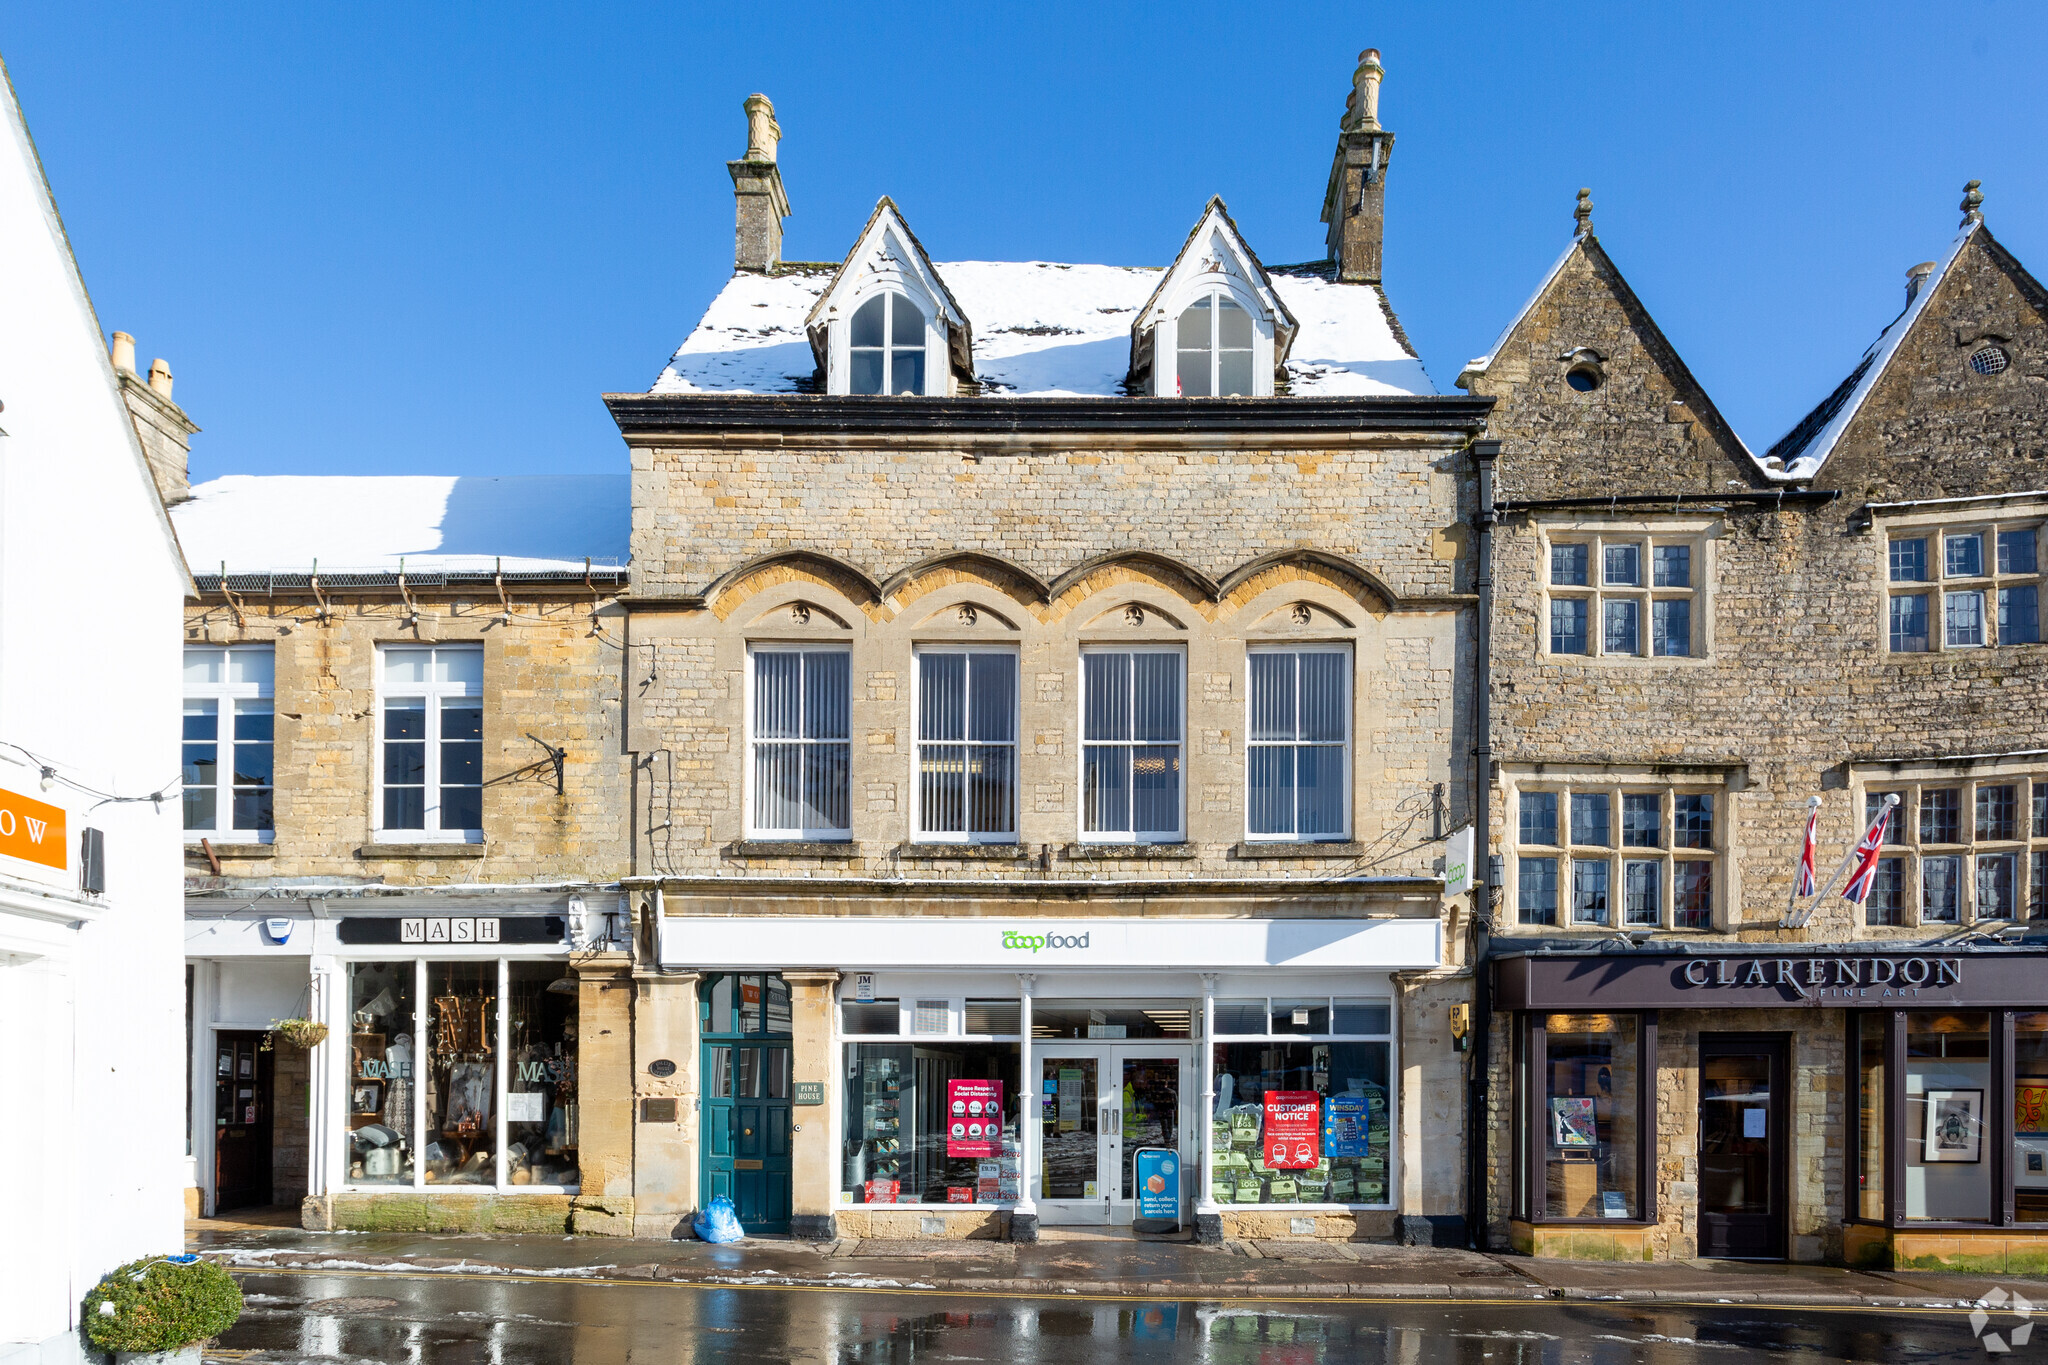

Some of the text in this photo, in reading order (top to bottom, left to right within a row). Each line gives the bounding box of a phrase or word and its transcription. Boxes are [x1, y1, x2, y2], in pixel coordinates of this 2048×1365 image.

[1448, 863, 1465, 885] coop
[405, 921, 494, 939] MASH
[858, 975, 871, 984] JM
[1684, 957, 1964, 997] CLARENDON
[1819, 988, 1920, 997] FINE ART
[362, 1059, 413, 1078] MASH
[517, 1061, 576, 1082] MASH
